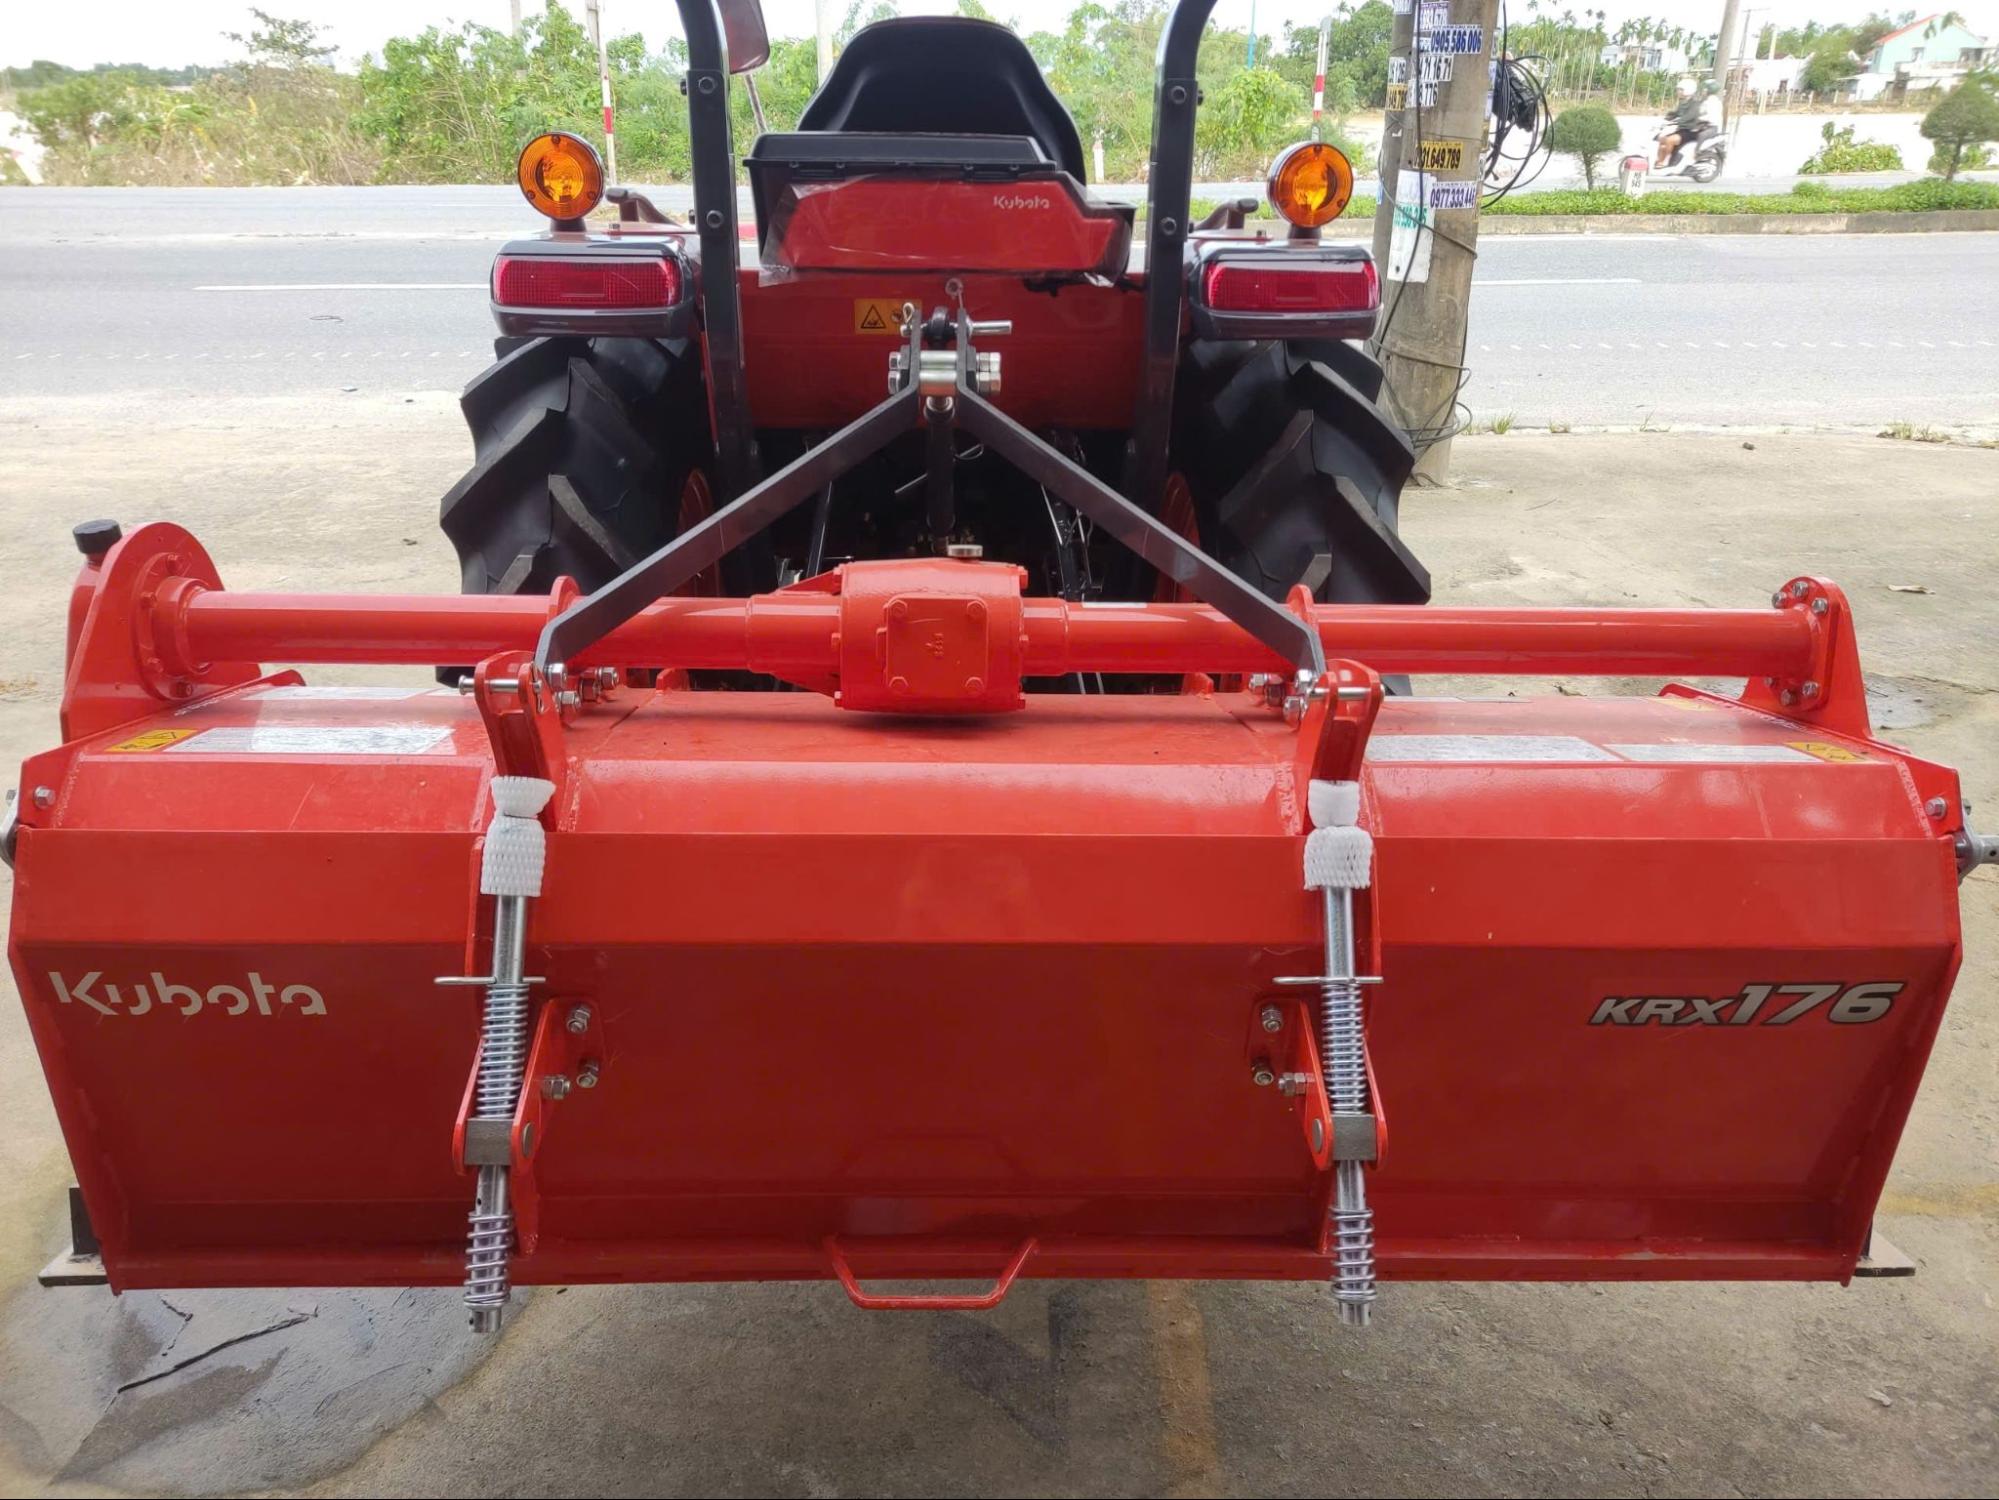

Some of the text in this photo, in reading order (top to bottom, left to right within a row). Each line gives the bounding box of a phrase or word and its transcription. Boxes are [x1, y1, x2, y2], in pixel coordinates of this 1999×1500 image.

[993, 195, 1048, 209] Kubota
[48, 971, 328, 1016] Kubota
[1588, 981, 1905, 1025] KRX176
